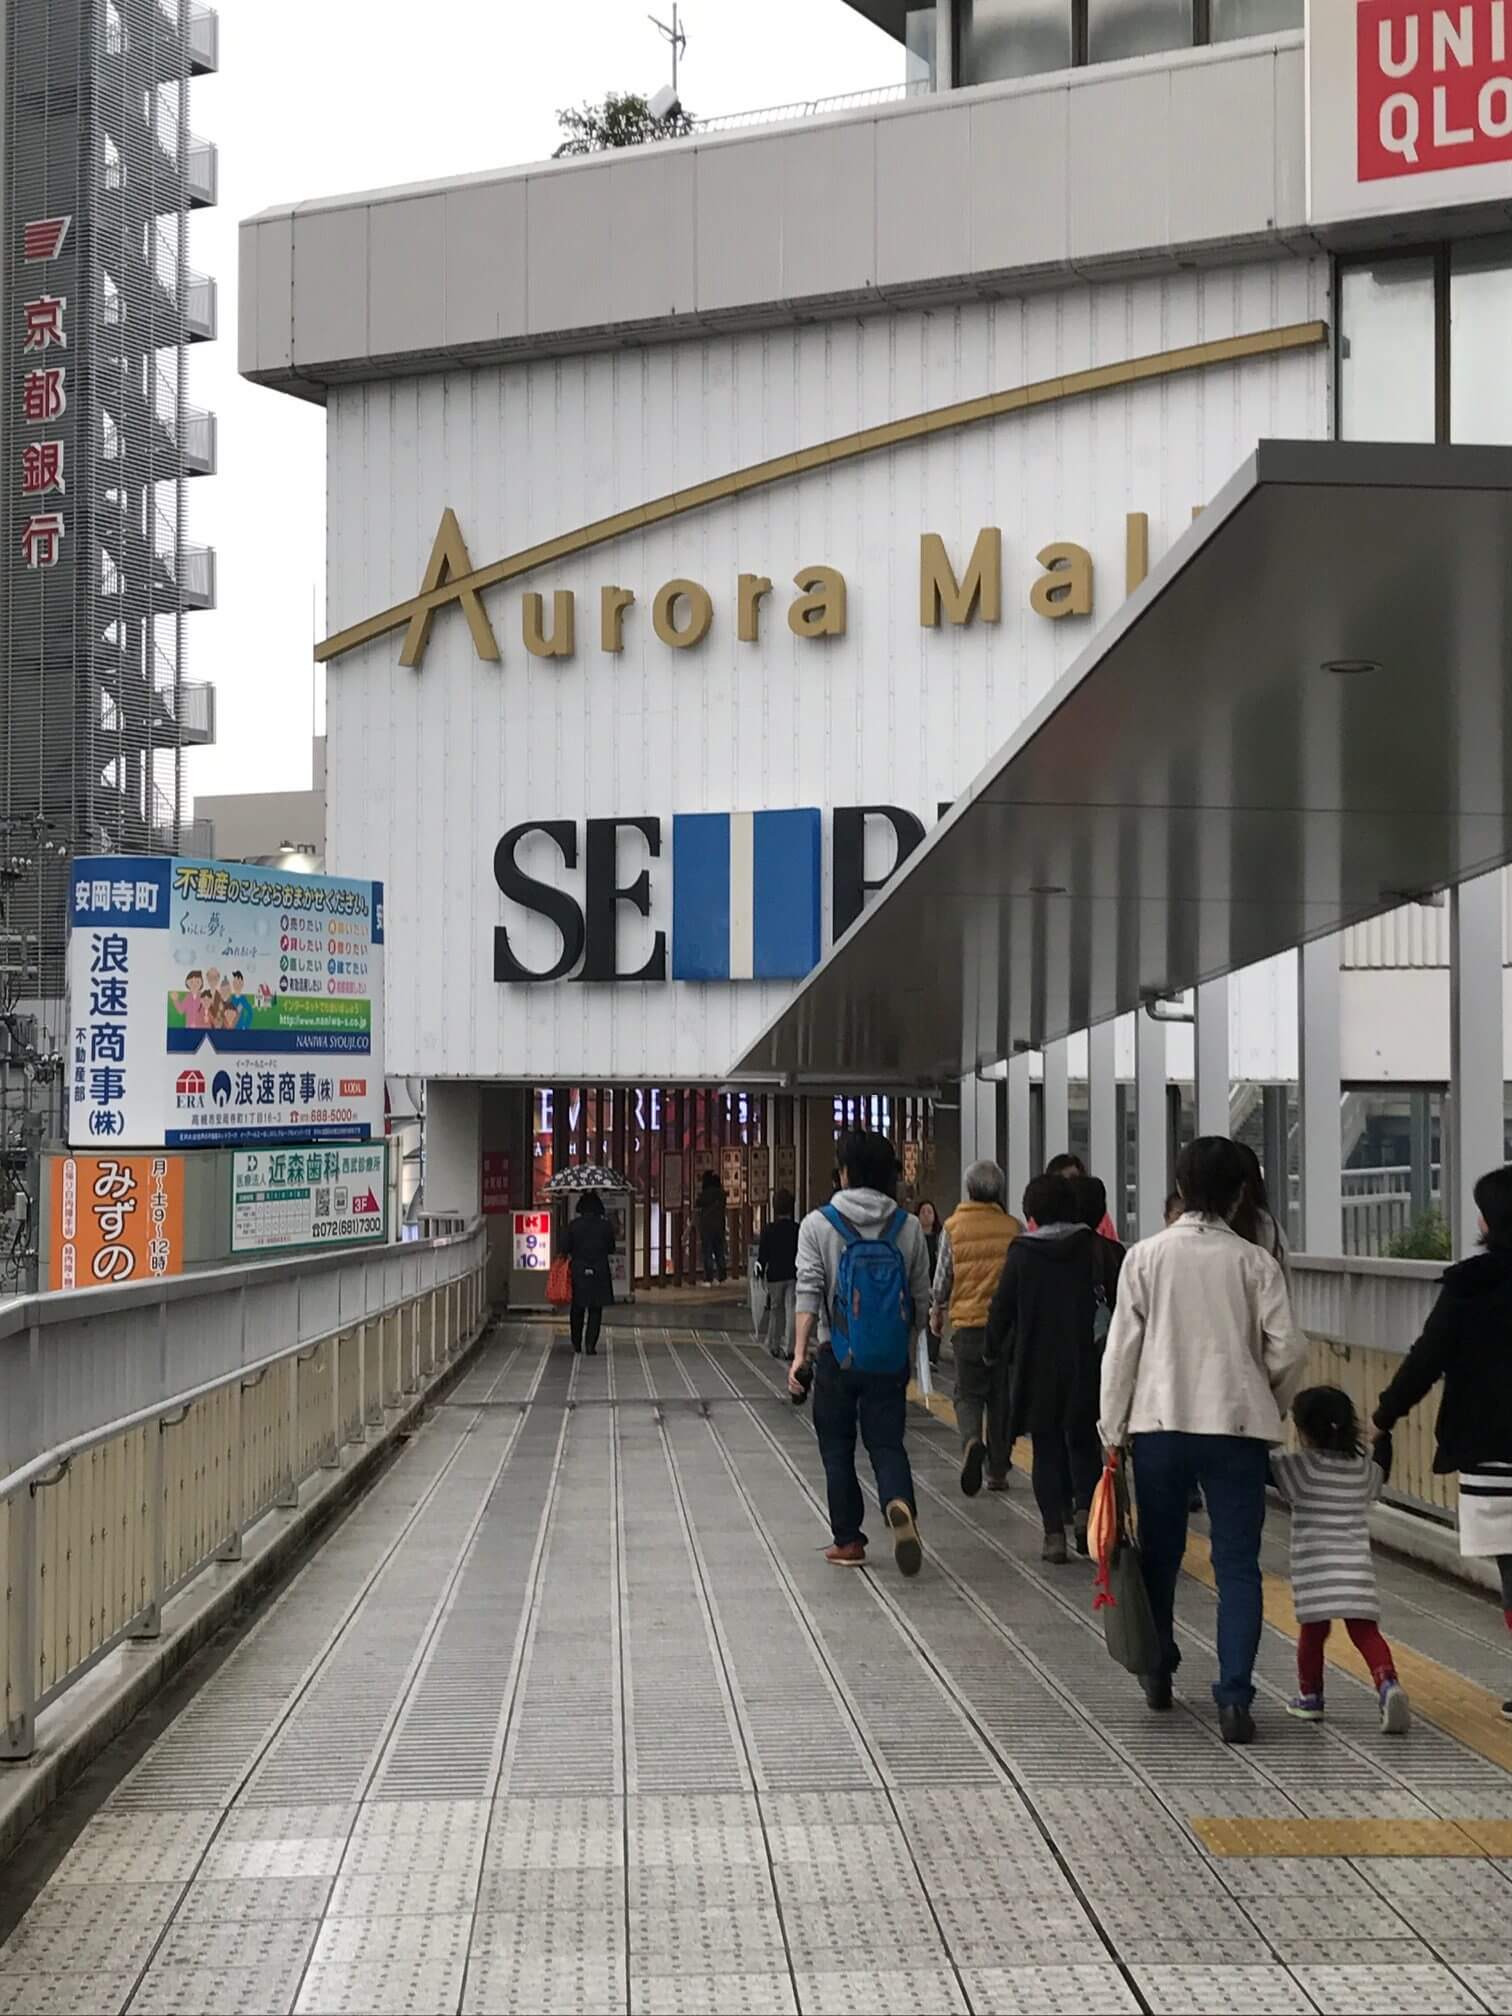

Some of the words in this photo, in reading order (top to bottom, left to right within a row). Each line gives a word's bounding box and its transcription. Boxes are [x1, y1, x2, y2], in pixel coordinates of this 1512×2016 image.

[1379, 1, 1505, 78] UNI
[1379, 76, 1512, 163] QLO
[22, 294, 66, 569] 京都銀行
[398, 506, 848, 667] Aurora
[920, 504, 1206, 628] Mal
[75, 880, 159, 913] 安岡寺町
[493, 803, 953, 983] SEI
[74, 1027, 87, 1102] 不動産部
[89, 933, 129, 1136] 浪速商事(株)
[176, 1095, 205, 1109] ERA
[235, 1071, 334, 1105] 浪速商事(株)
[268, 1151, 339, 1185] 近森歯科
[354, 1197, 369, 1213] 3F
[91, 1159, 137, 1281] みずの
